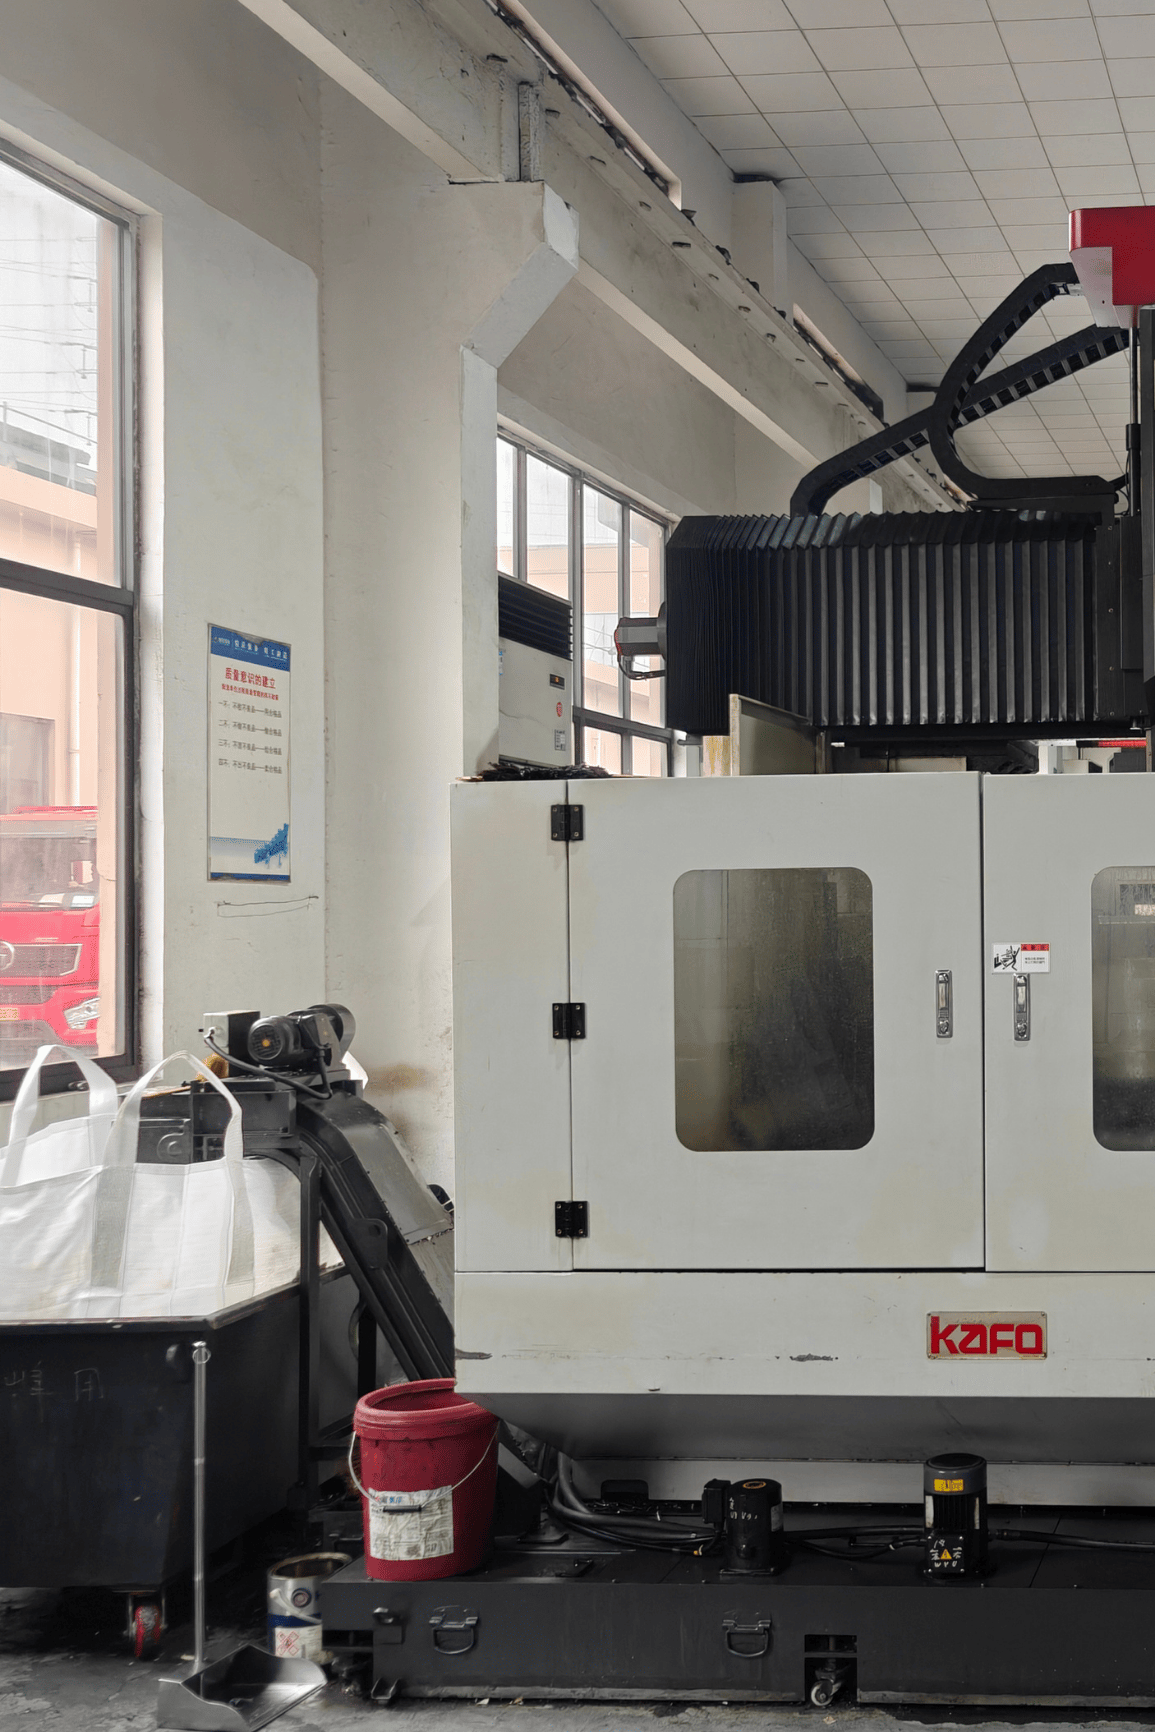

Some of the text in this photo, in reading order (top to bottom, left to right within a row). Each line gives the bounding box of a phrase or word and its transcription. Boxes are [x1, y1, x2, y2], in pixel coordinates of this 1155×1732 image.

[225, 667, 276, 689] 质量意识的建立
